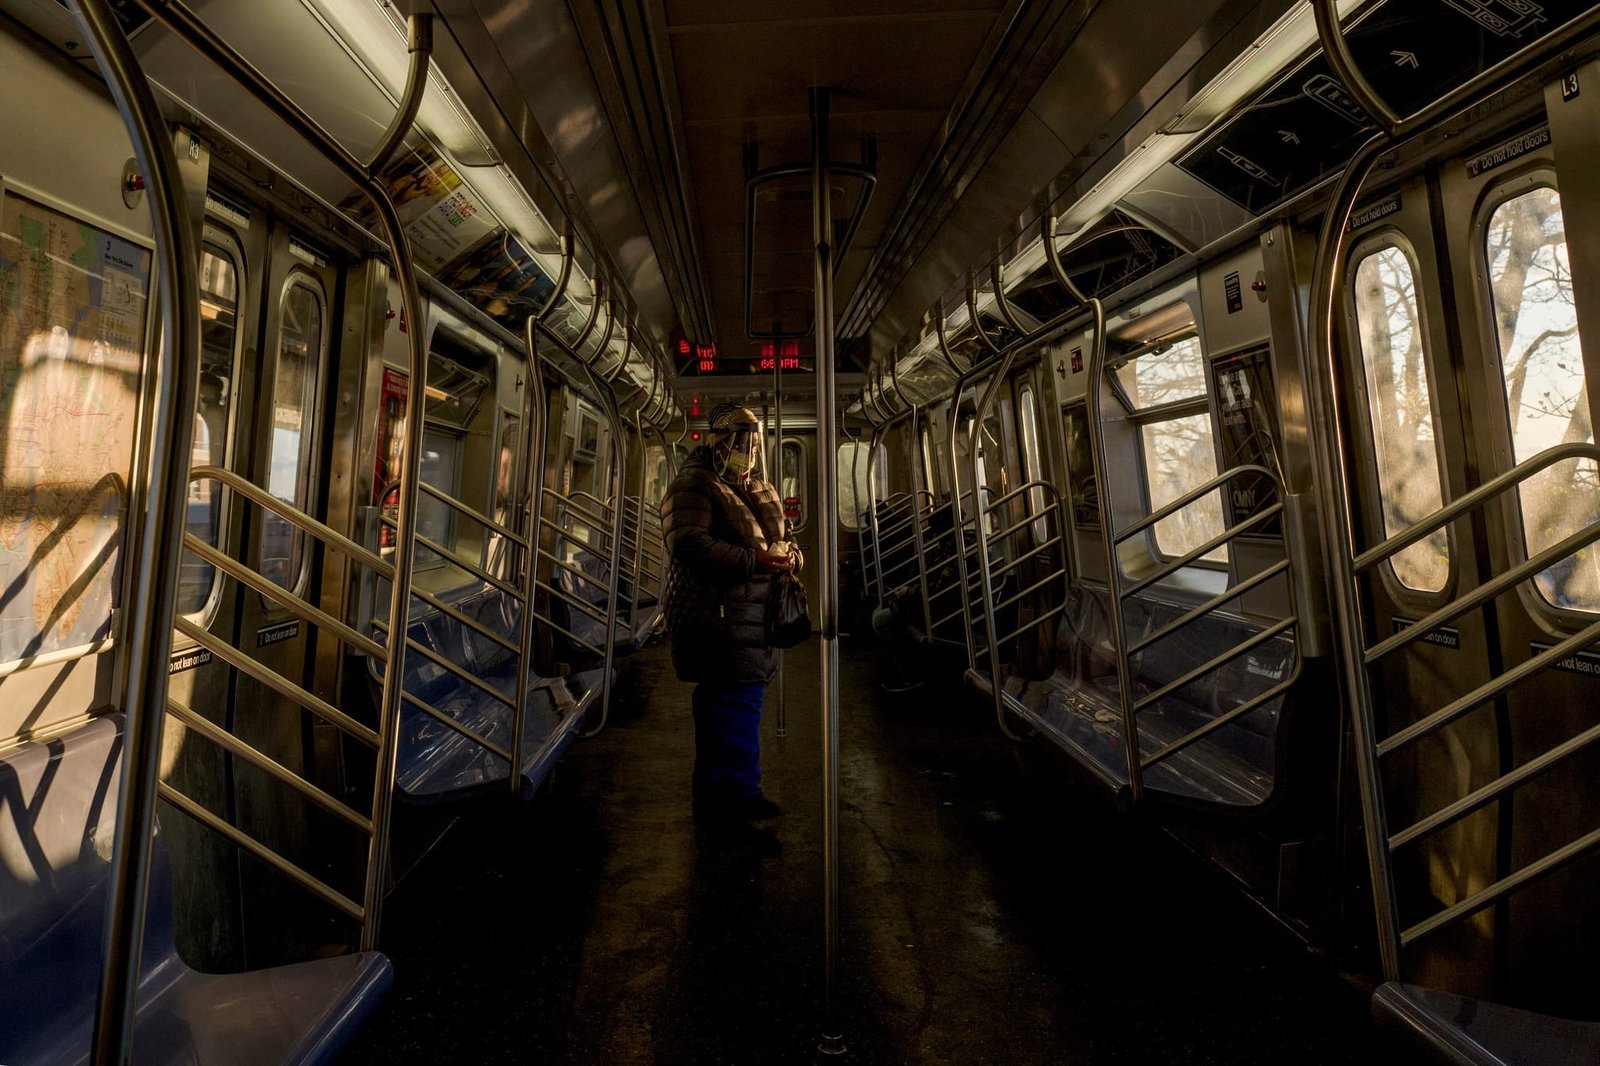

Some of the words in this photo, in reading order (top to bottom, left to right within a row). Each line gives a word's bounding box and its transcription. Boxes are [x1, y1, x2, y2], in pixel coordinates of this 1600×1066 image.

[1561, 73, 1578, 97] L3
[189, 141, 200, 160] R3
[1482, 157, 1494, 170] Do
[1494, 149, 1507, 164] not
[1506, 138, 1524, 157] hold
[1524, 130, 1549, 149] doors
[1353, 216, 1361, 228] Do
[1370, 205, 1381, 220] hold
[1381, 200, 1398, 215] doors
[1443, 633, 1457, 646] door
[173, 657, 183, 671] not
[182, 656, 193, 669] lean
[193, 655, 200, 665] on
[200, 651, 211, 663] door
[1575, 657, 1594, 673] lean
